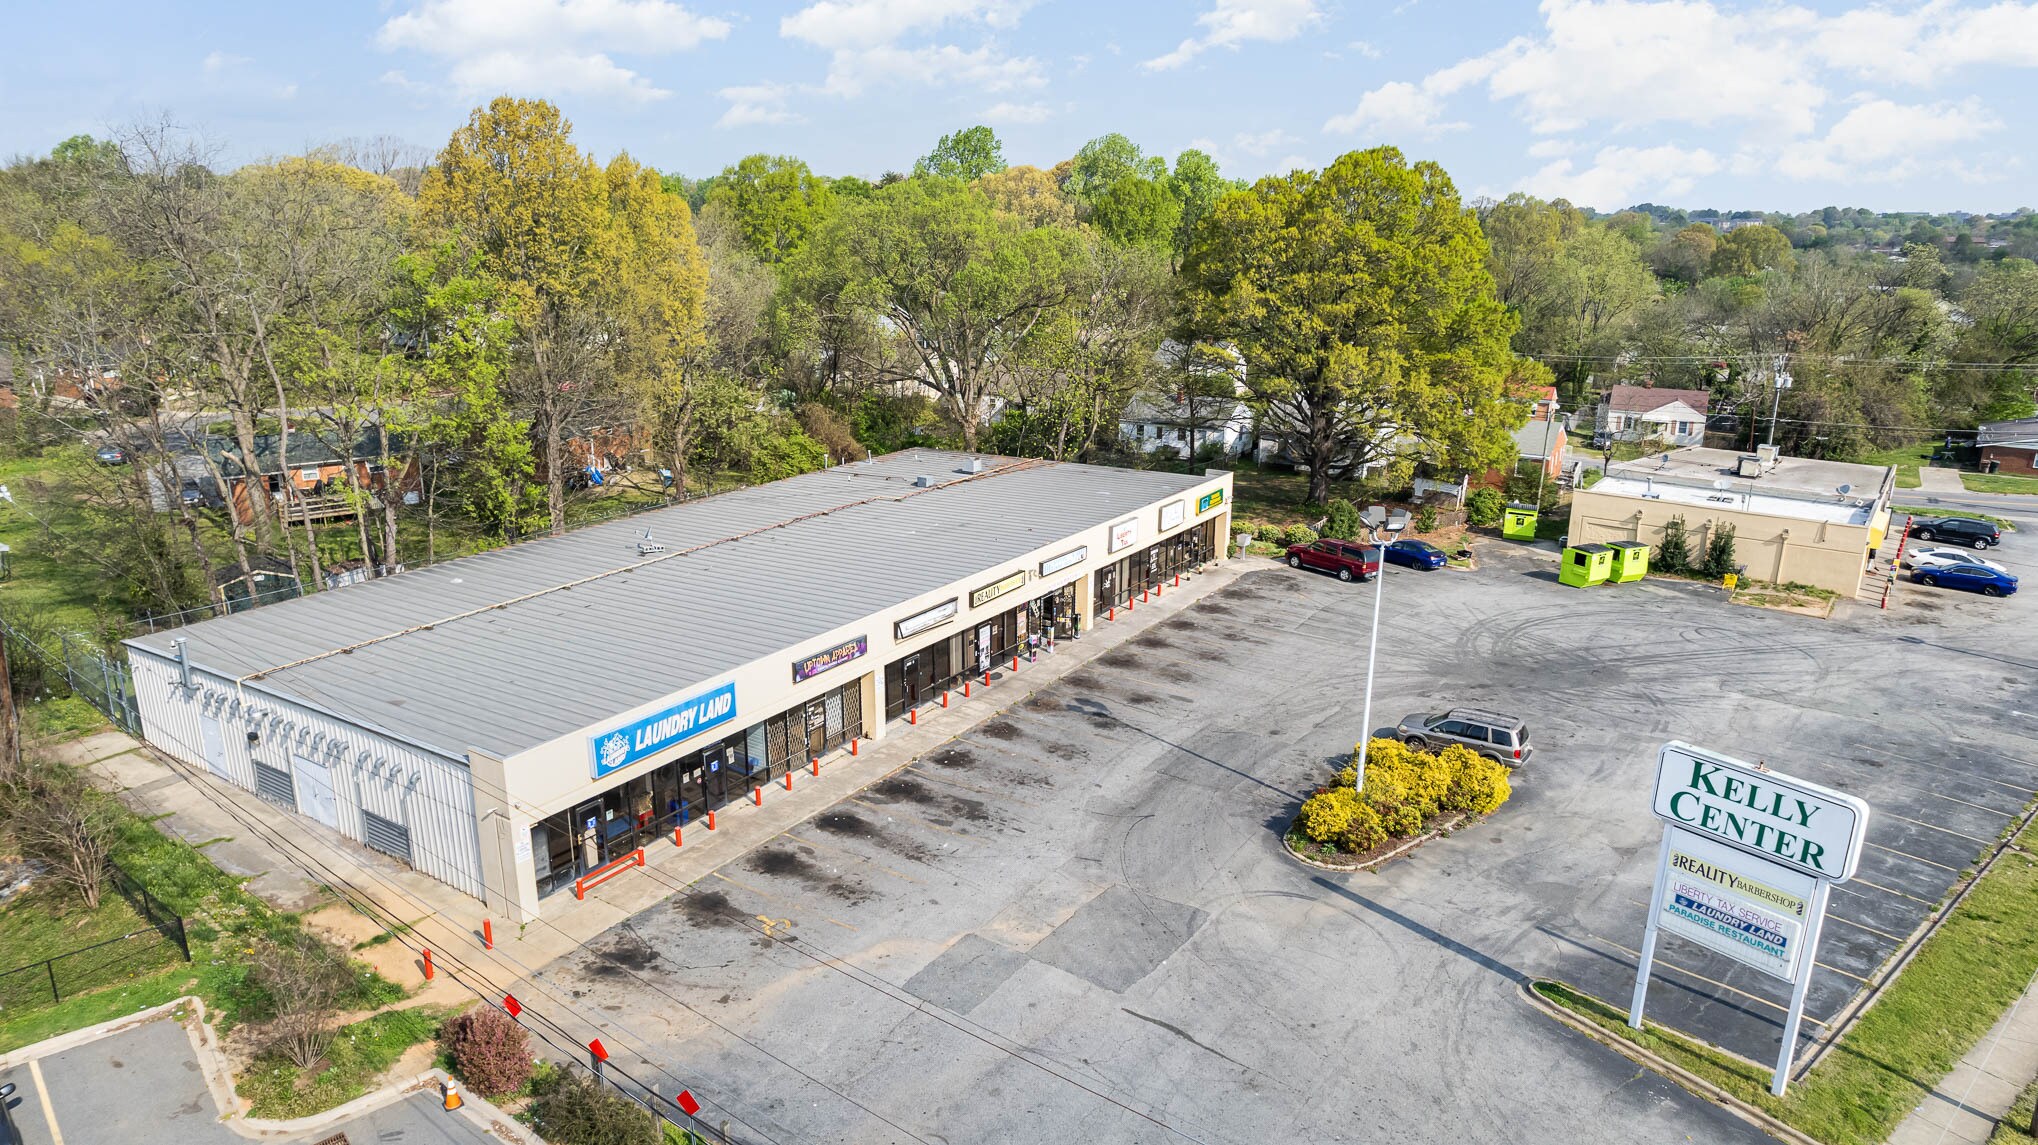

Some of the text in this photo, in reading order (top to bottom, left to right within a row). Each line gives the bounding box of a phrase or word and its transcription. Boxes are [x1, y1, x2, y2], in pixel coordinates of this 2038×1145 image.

[977, 584, 1000, 603] REALITY
[803, 653, 830, 675] UPTOWN
[634, 692, 732, 752] LAUNDRY LAND
[1686, 760, 1822, 828] KELLY
[1670, 791, 1825, 871] CENTER
[1673, 881, 1783, 933] LIBERTY TAX SERVICE
[1679, 855, 1796, 910] REALITY BARBERSHOP
[1668, 903, 1785, 958] PARADISE RESTAURANT
[1692, 902, 1784, 945] LAUNDRY LAND
